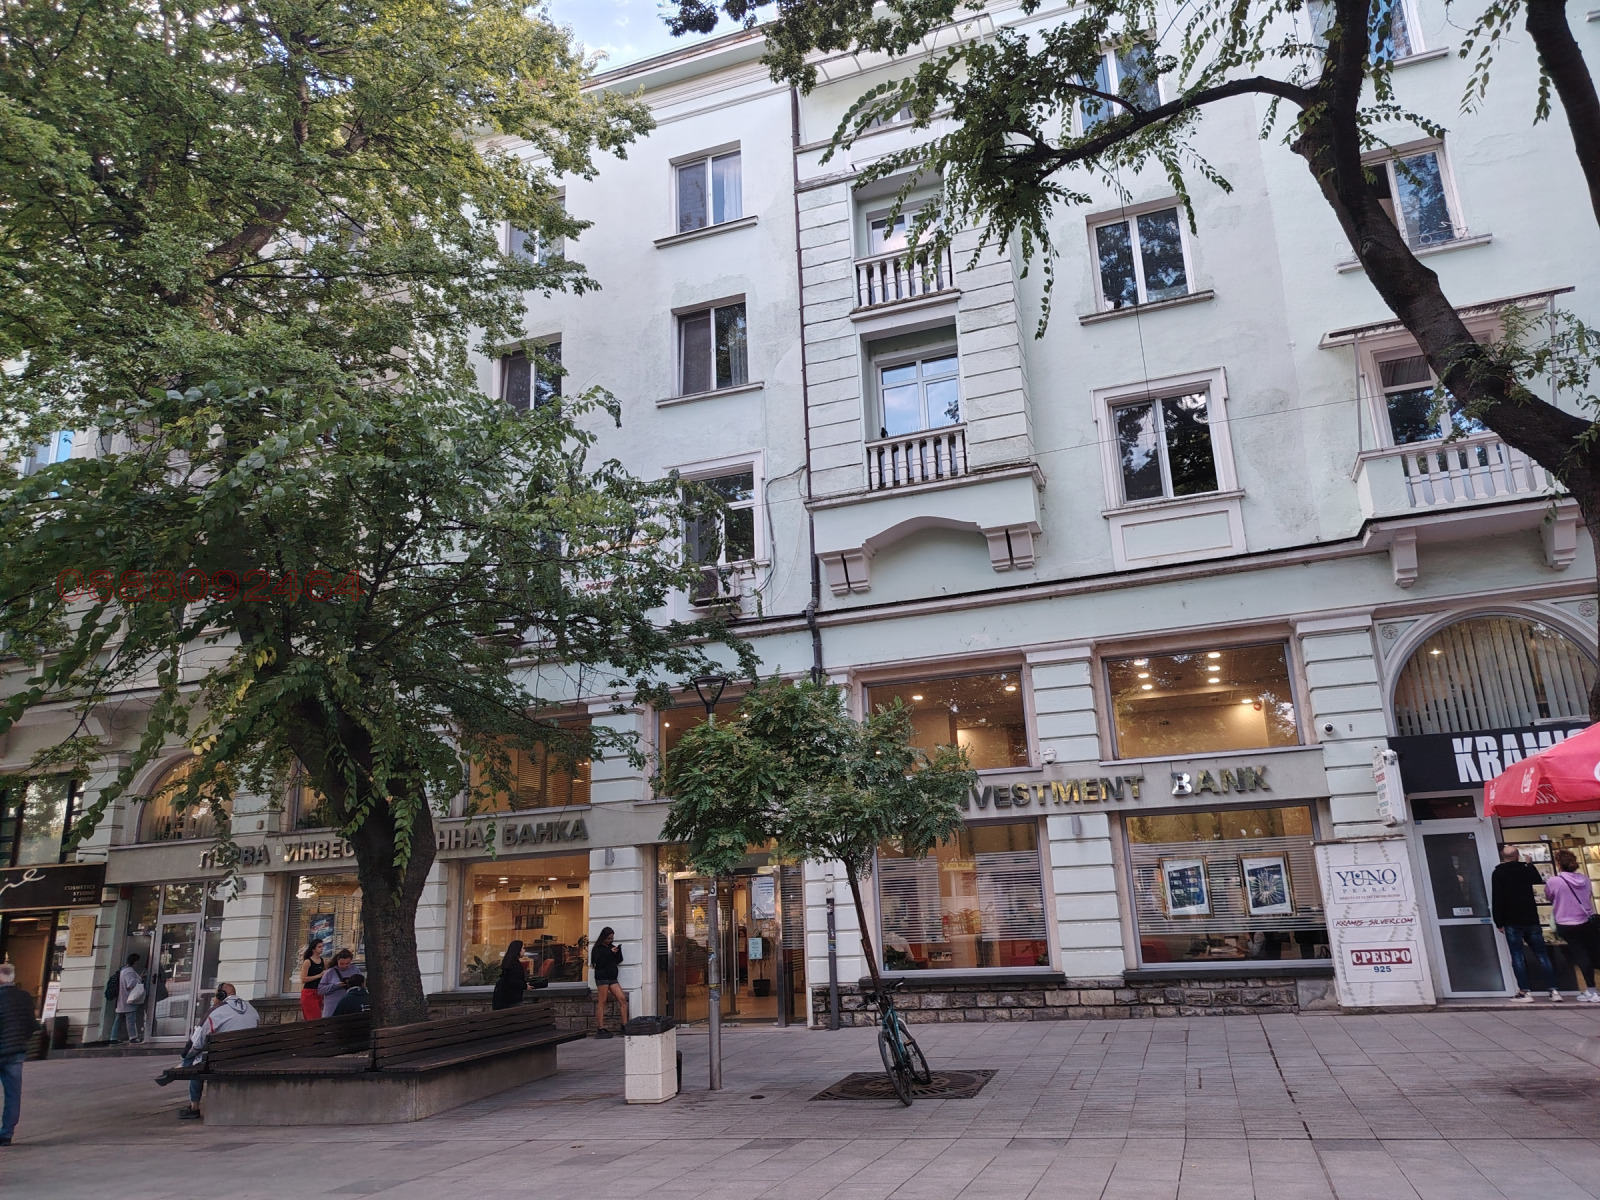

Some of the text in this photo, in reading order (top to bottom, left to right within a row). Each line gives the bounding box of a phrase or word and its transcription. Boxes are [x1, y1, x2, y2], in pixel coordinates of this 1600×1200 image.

[1452, 728, 1584, 783] KRAM
[960, 766, 1271, 809] VESTMENT BANK
[197, 844, 271, 868] ПВА
[502, 818, 589, 846] БАНКА
[1335, 868, 1397, 887] YUNO
[1342, 886, 1397, 894] PEARLS
[1351, 949, 1411, 964] СРЕБРО
[1373, 965, 1392, 973] 925
